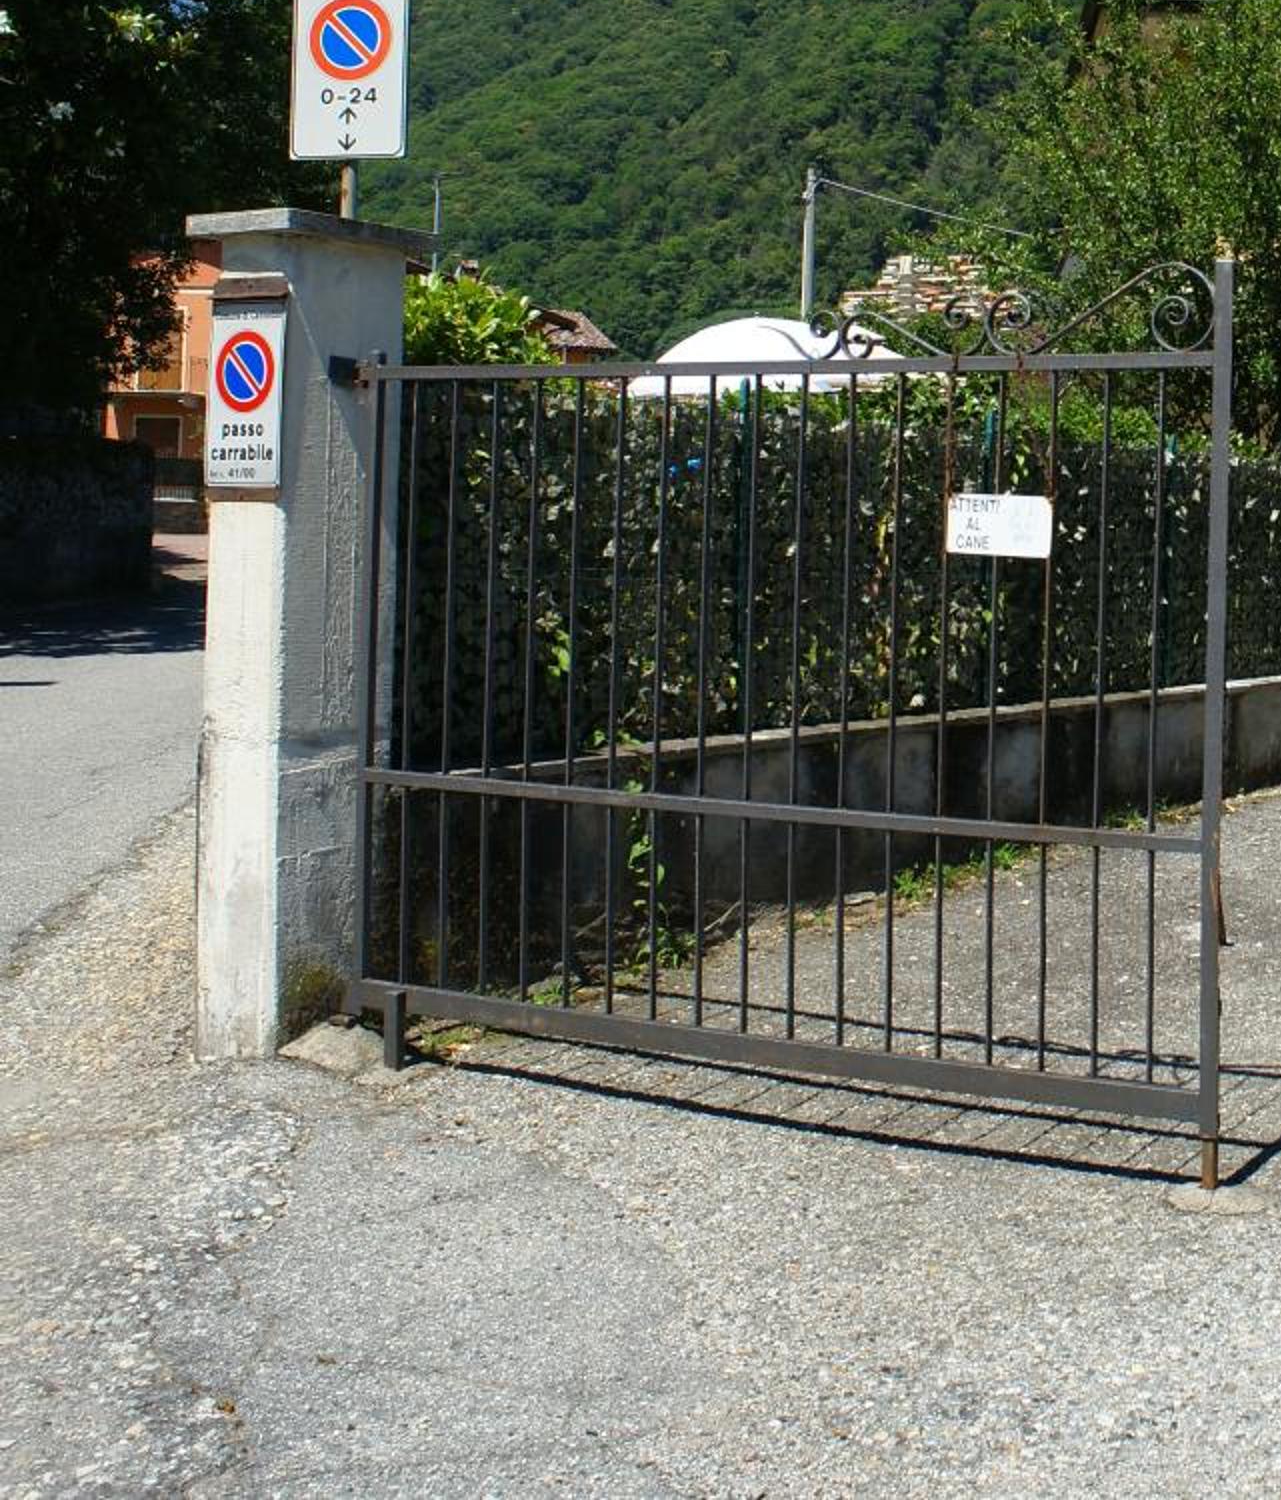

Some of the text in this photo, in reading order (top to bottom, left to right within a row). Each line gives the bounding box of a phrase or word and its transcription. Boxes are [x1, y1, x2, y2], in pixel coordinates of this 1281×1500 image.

[321, 87, 377, 104] 0-24
[222, 423, 264, 440] passo
[211, 444, 273, 461] carrabile
[966, 517, 980, 531] AL
[956, 534, 989, 550] CANE
